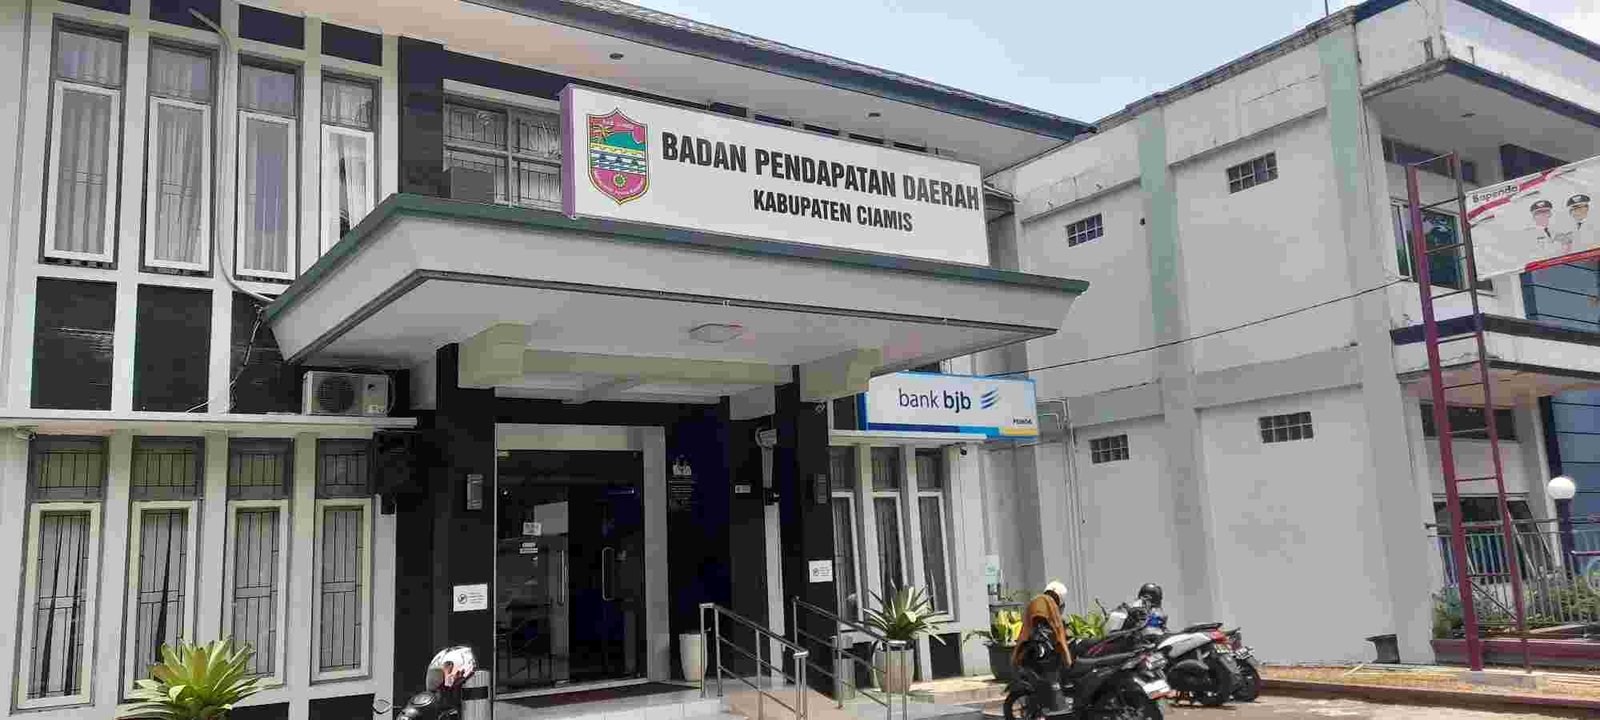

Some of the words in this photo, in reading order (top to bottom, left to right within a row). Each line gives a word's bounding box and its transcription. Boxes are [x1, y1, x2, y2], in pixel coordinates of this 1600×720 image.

[662, 132, 746, 172] BADAN
[755, 149, 896, 197] PENDAPATAN
[903, 174, 980, 210] DAERAH
[753, 189, 851, 223] KABUPATEN
[856, 205, 913, 232] CIAMIS
[899, 388, 939, 408] bank
[943, 390, 971, 412] bjb
